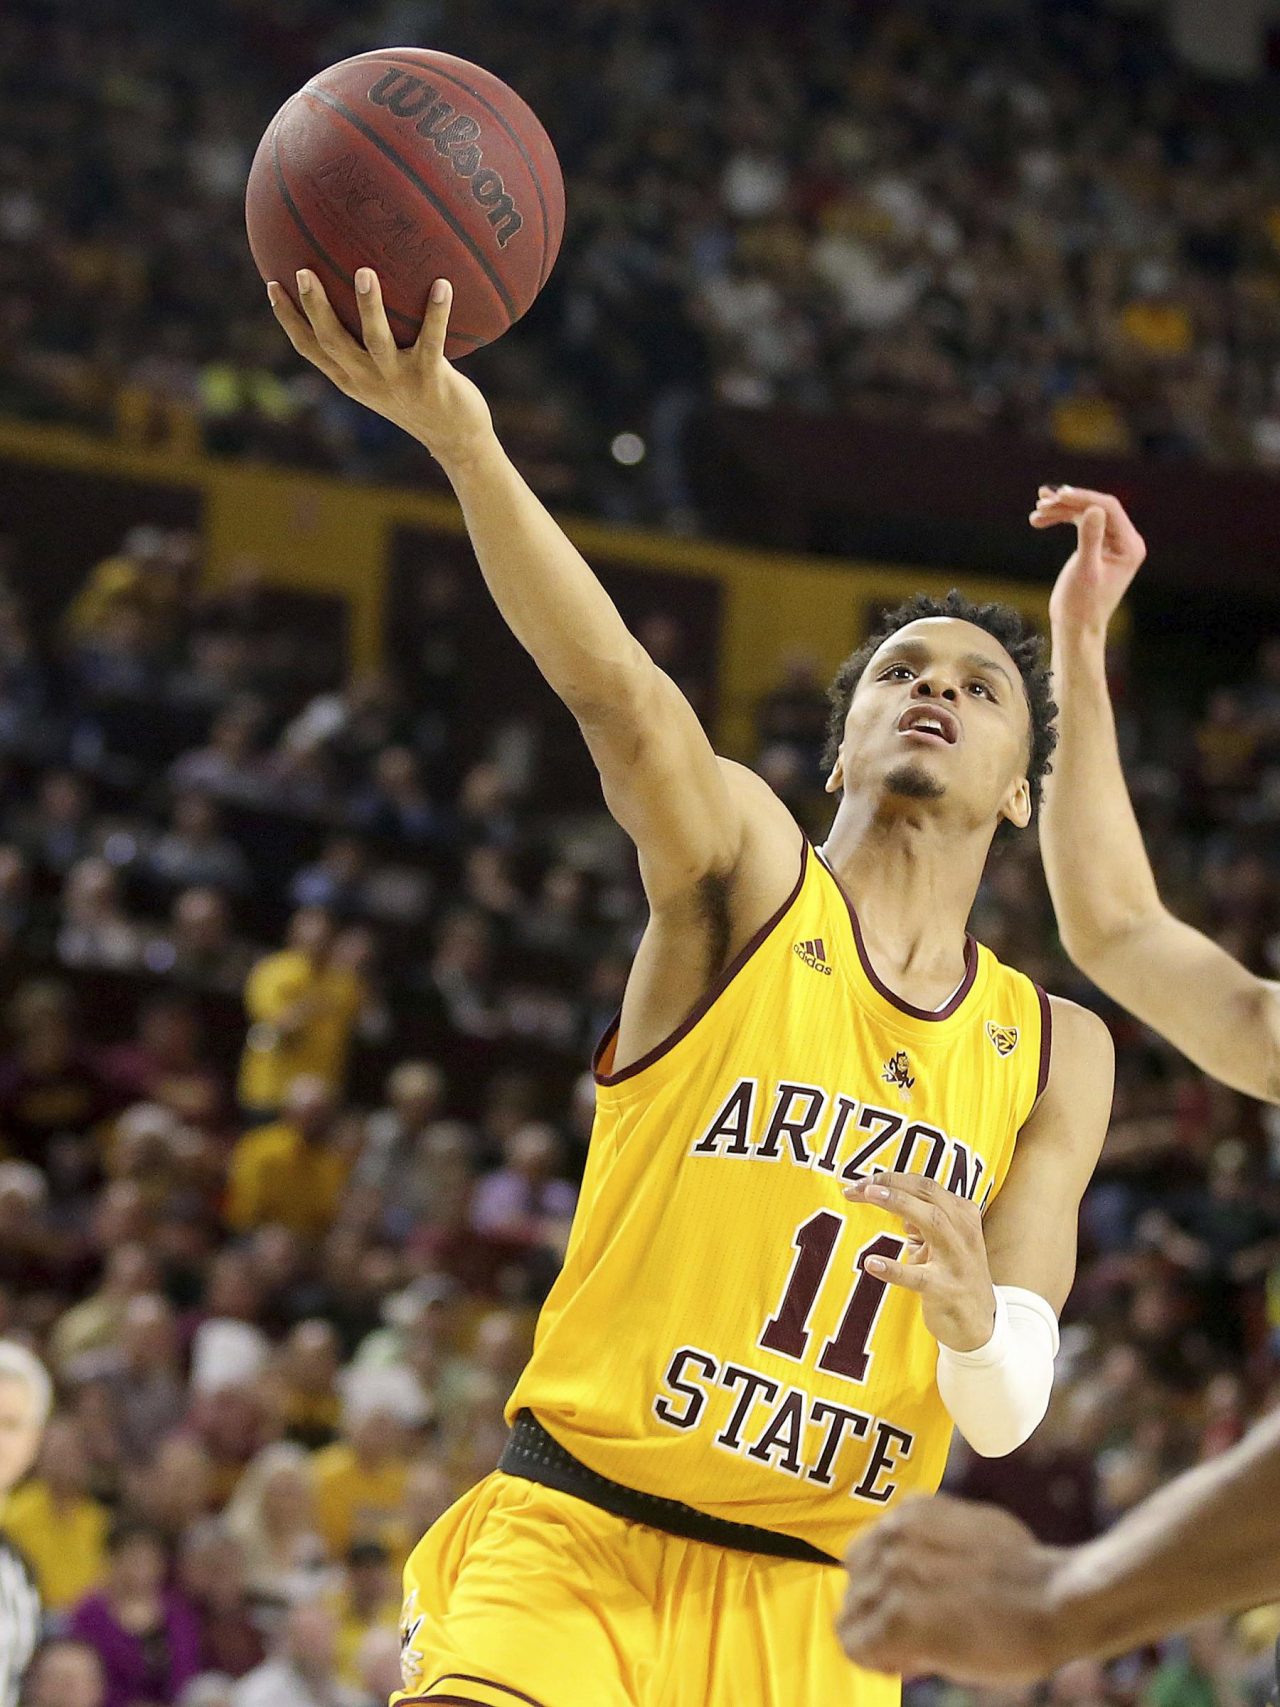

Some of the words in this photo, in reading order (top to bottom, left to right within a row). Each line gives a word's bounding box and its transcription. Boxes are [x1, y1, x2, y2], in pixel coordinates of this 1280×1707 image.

[368, 67, 523, 249] Wilson
[793, 944, 833, 976] adidas
[689, 1077, 995, 1214] ARIZON
[757, 1207, 907, 1385] 11
[653, 1345, 915, 1504] STATE
